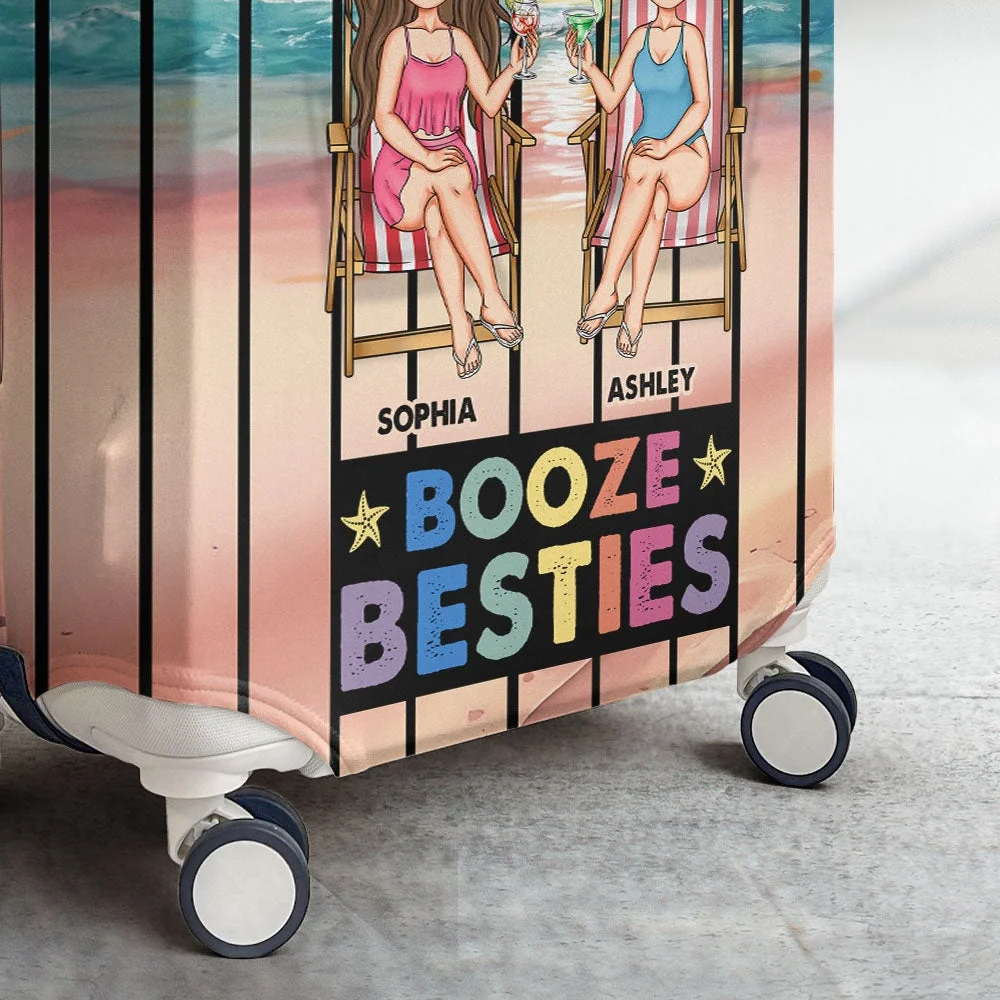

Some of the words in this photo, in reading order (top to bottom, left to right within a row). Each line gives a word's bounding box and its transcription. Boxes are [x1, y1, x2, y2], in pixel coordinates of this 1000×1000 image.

[377, 396, 477, 435] SOPHIA
[607, 366, 696, 403] ASHLEY
[406, 430, 680, 553] BOOZE
[340, 513, 730, 692] BESTIES
